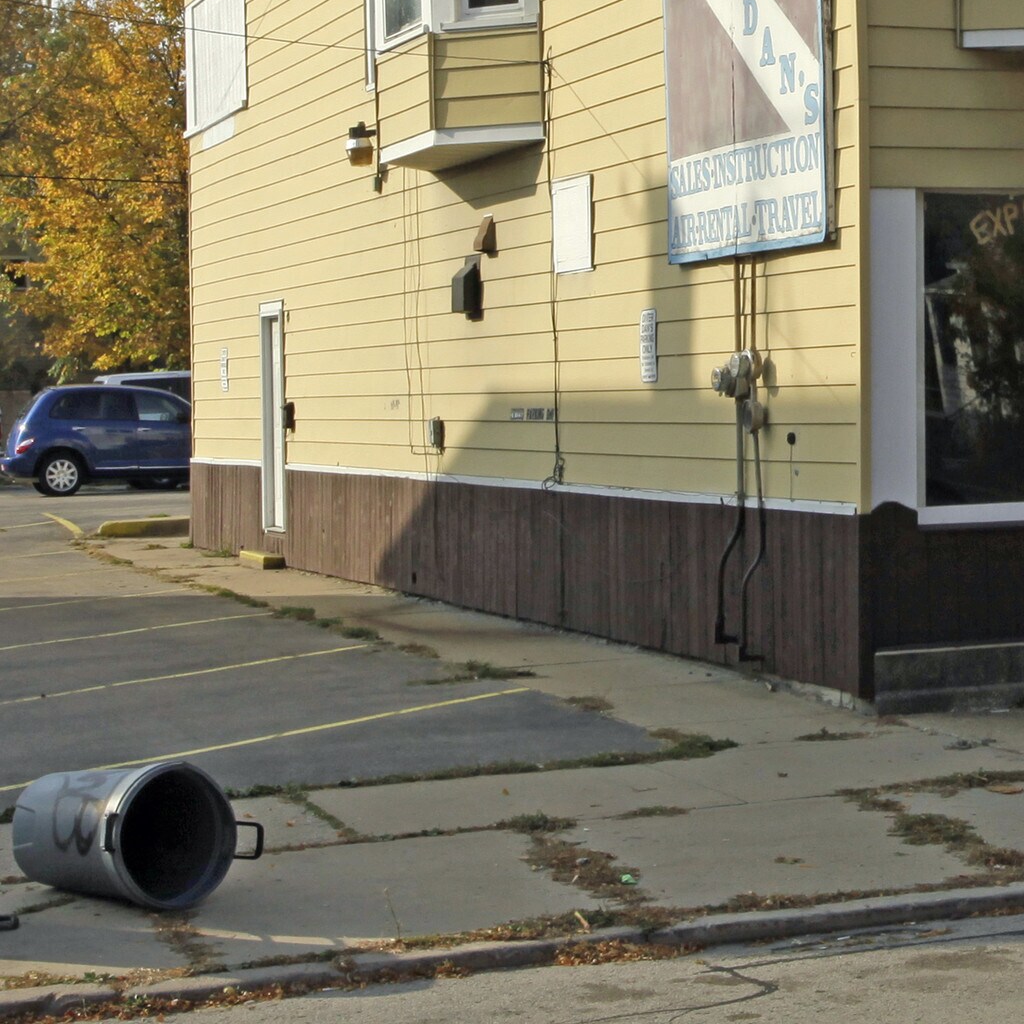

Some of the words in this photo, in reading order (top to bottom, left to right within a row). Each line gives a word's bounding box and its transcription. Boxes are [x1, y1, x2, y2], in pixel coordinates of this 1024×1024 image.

[671, 157, 711, 199] SALES
[712, 132, 820, 189] INSTRUCTION
[671, 213, 699, 250] AIR
[700, 202, 752, 246] RENTAL
[755, 190, 820, 236] TRAVEL
